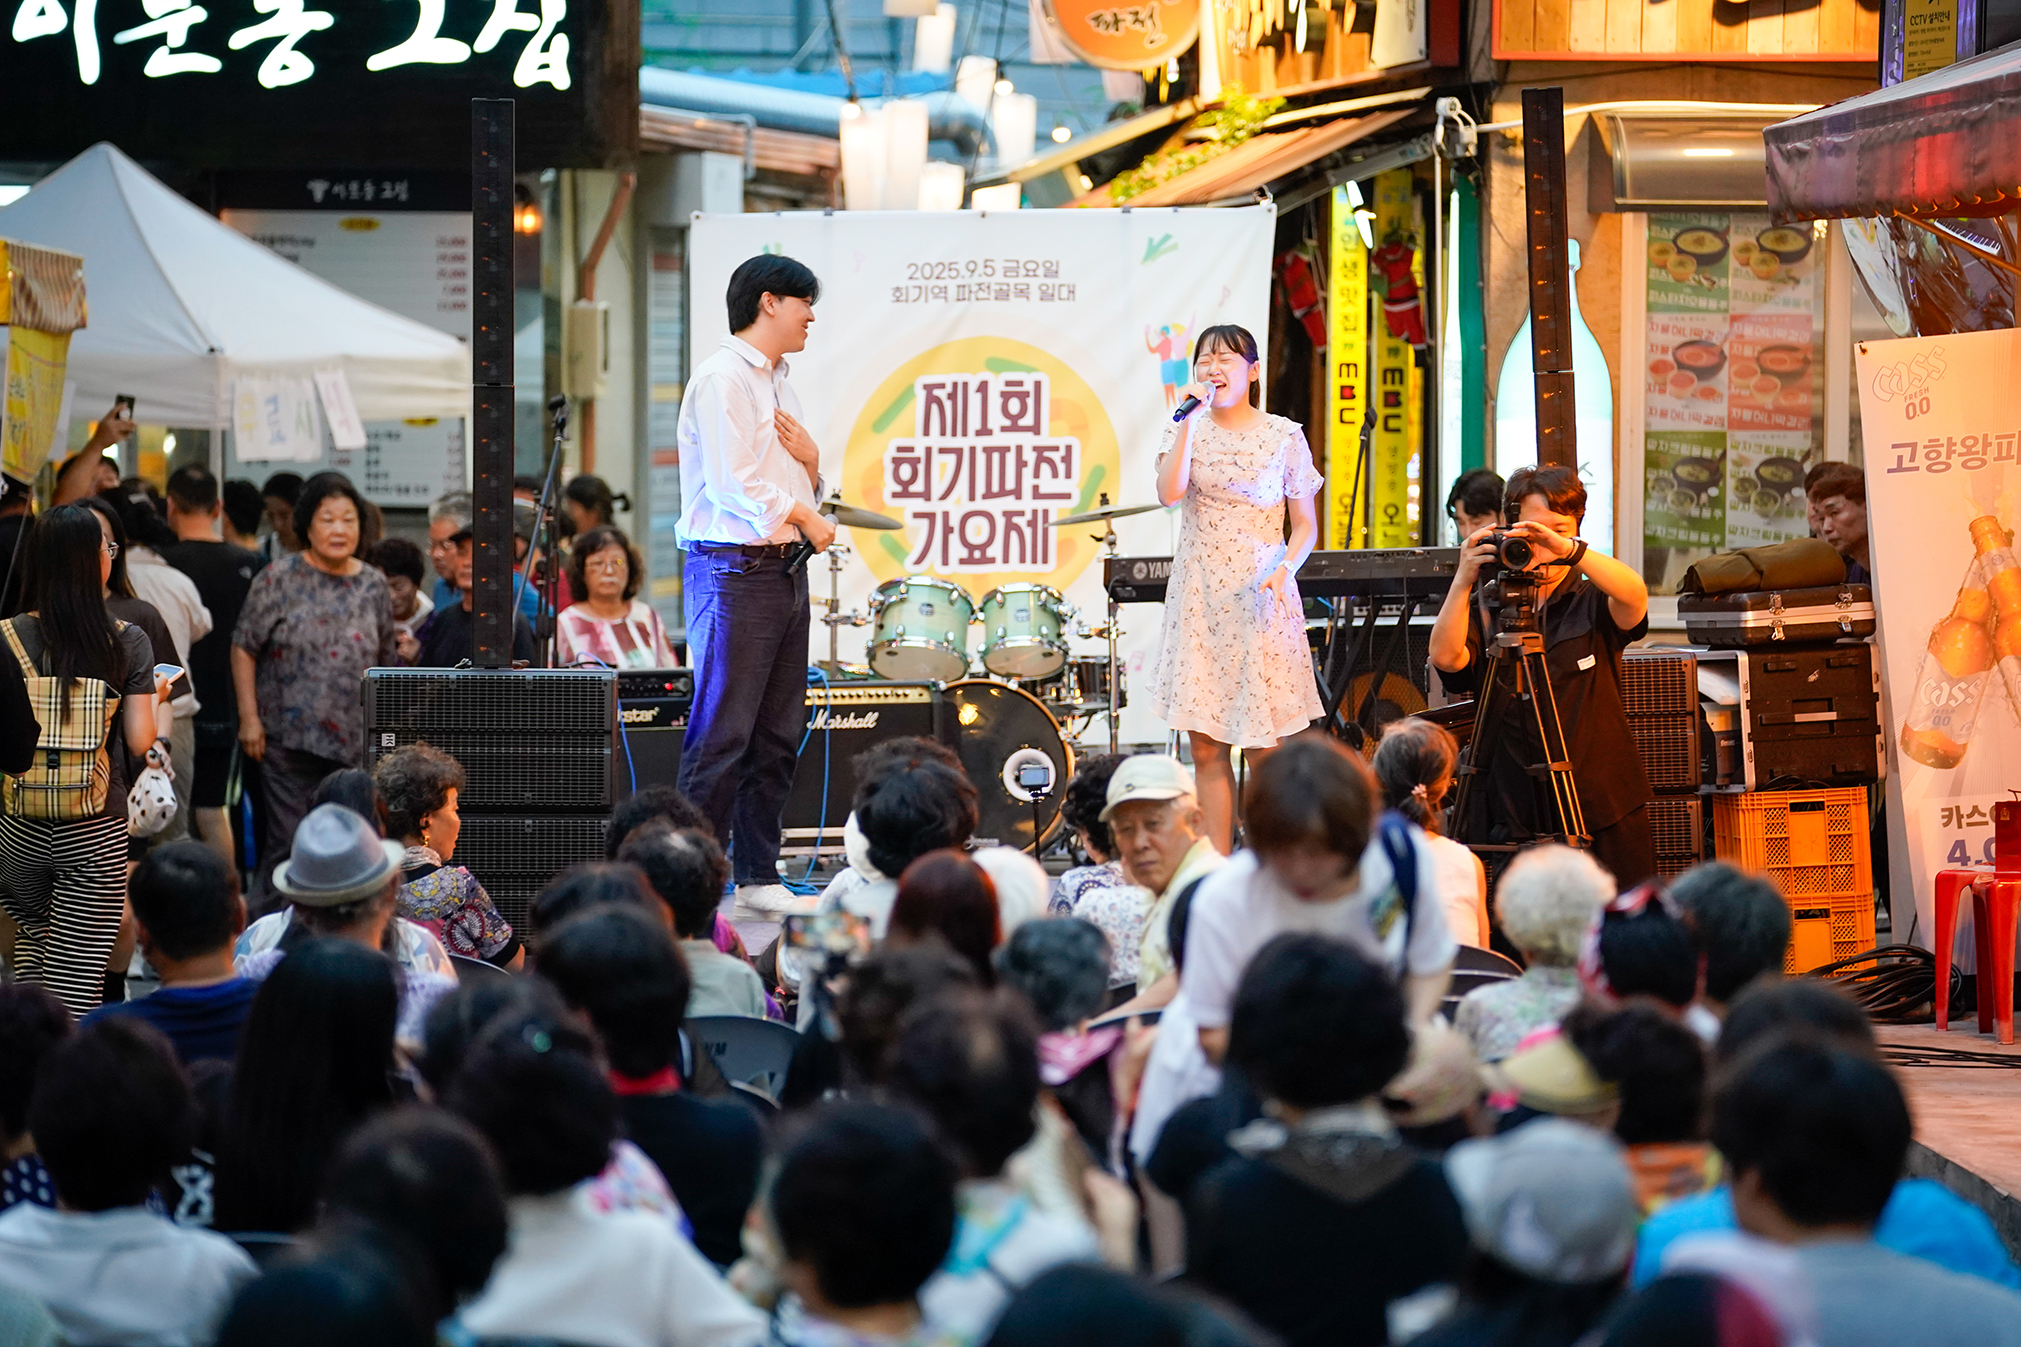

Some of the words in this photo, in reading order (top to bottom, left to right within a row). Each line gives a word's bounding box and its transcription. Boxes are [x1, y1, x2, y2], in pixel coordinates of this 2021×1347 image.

[1909, 12, 1928, 26] CCTV
[907, 259, 996, 280] 2025.9.5
[1002, 259, 1060, 279] 금요일
[891, 284, 949, 304] 회기역
[956, 282, 1031, 302] 파전골목
[1038, 283, 1077, 302] 일대
[1338, 362, 1358, 425] MBC
[1382, 367, 1404, 434] MBC
[1904, 387, 1930, 403] FRESH
[923, 380, 1042, 437] 제1회
[1905, 396, 1931, 420] 0.0
[891, 444, 1073, 502] 회기파전
[912, 508, 1050, 567] 가요제
[806, 708, 879, 730] Marshall
